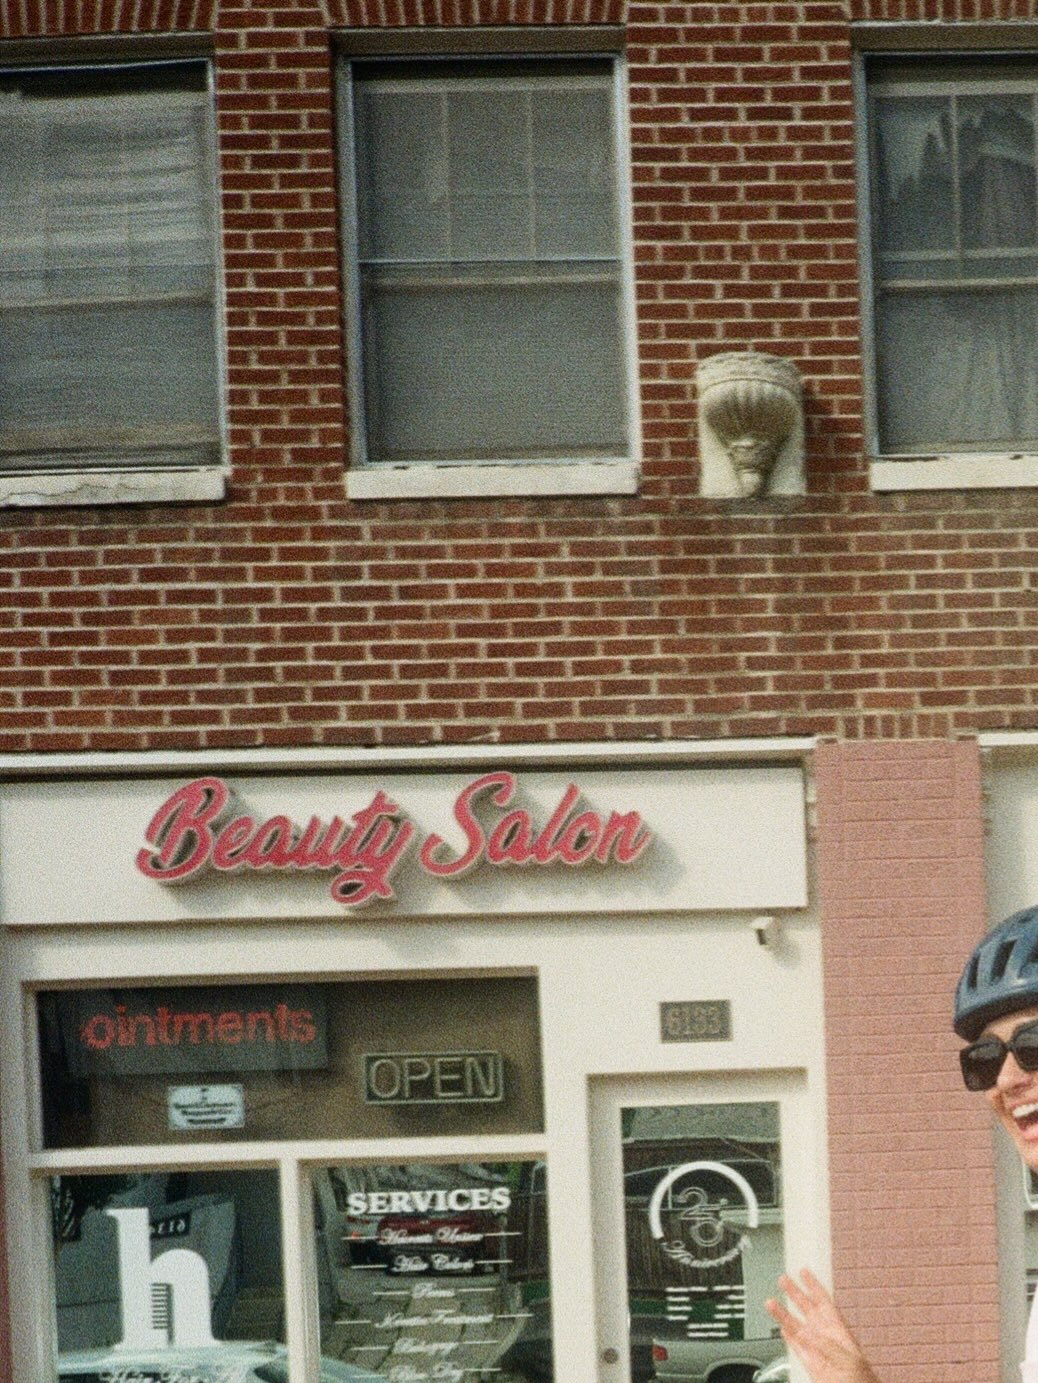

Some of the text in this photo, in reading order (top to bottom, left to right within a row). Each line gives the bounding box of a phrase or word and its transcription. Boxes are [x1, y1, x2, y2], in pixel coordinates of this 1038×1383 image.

[135, 771, 651, 905] Beauty Salon
[80, 1002, 317, 1050] ointments
[368, 1056, 497, 1099] OPEN
[346, 1187, 512, 1216] SERVICES
